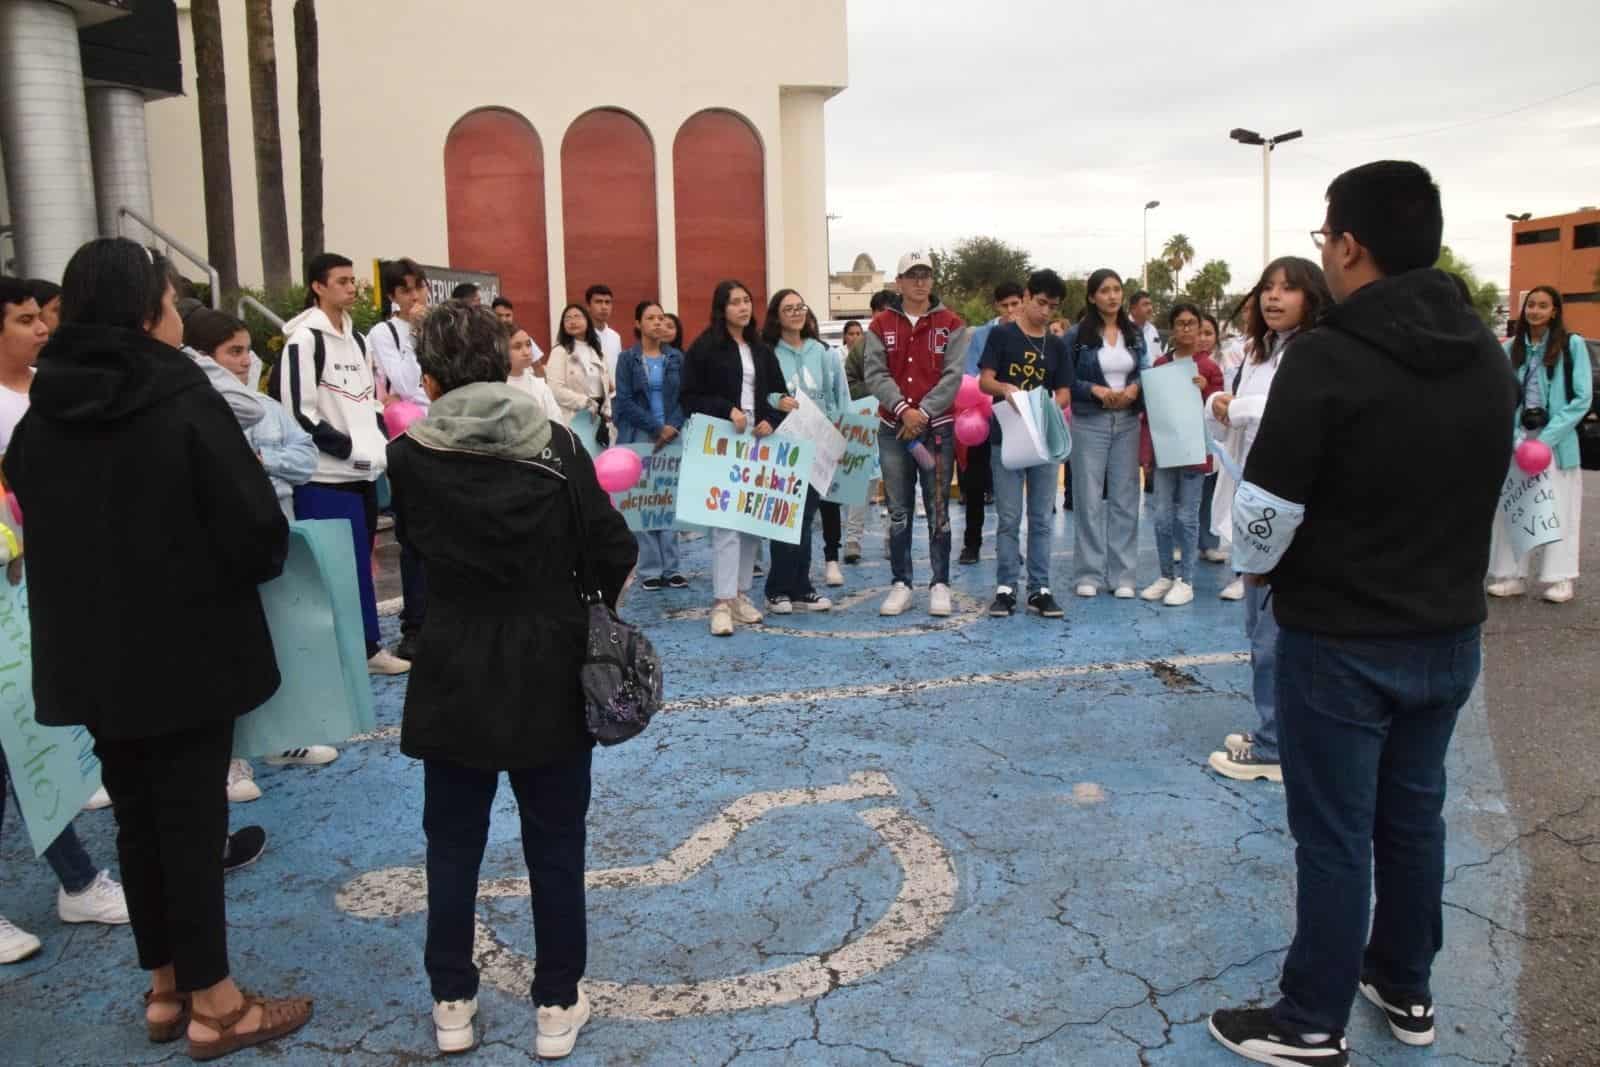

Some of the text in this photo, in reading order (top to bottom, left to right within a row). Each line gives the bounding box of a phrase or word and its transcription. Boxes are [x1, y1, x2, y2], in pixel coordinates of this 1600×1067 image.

[704, 424, 800, 467] La vida NO
